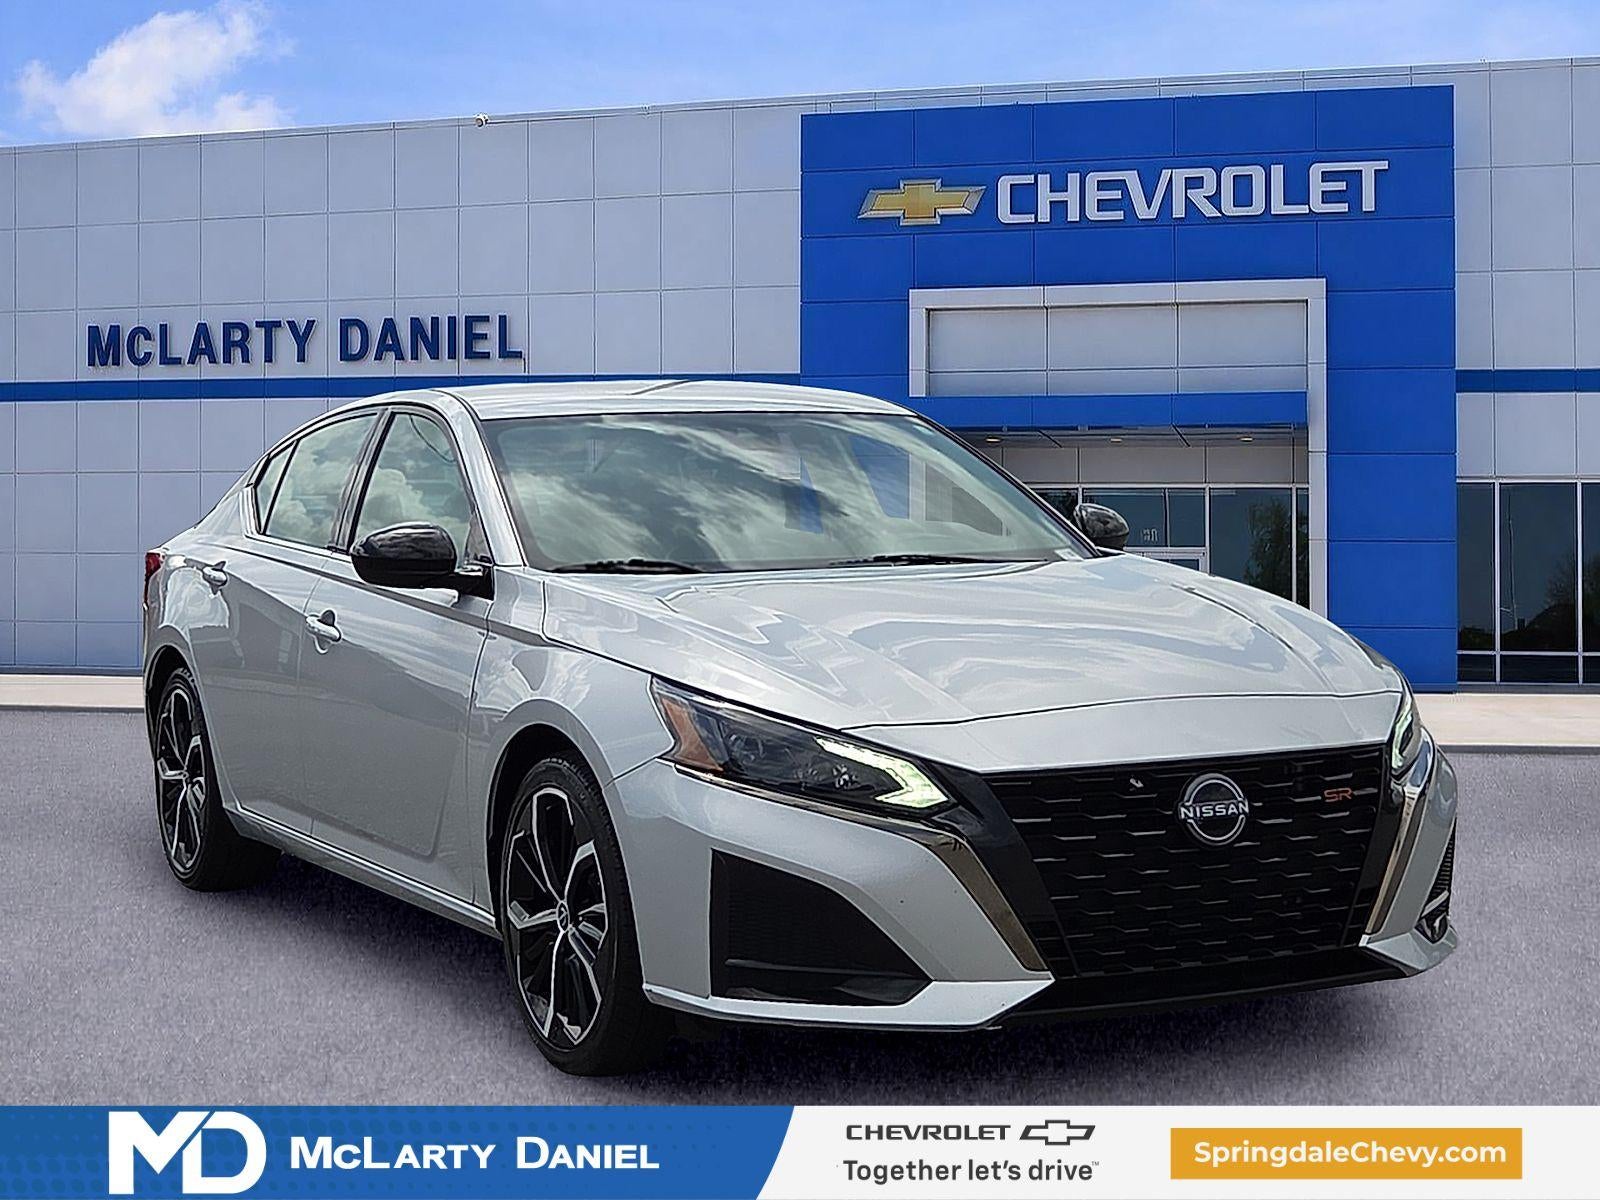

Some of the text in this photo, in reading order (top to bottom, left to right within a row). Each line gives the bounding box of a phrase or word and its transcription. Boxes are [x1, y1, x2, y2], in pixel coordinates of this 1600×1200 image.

[997, 160, 1389, 224] CHEVROLET
[86, 313, 525, 367] MCLARTY DANIEL
[1180, 801, 1250, 820] NISSAN
[1324, 788, 1352, 802] SR
